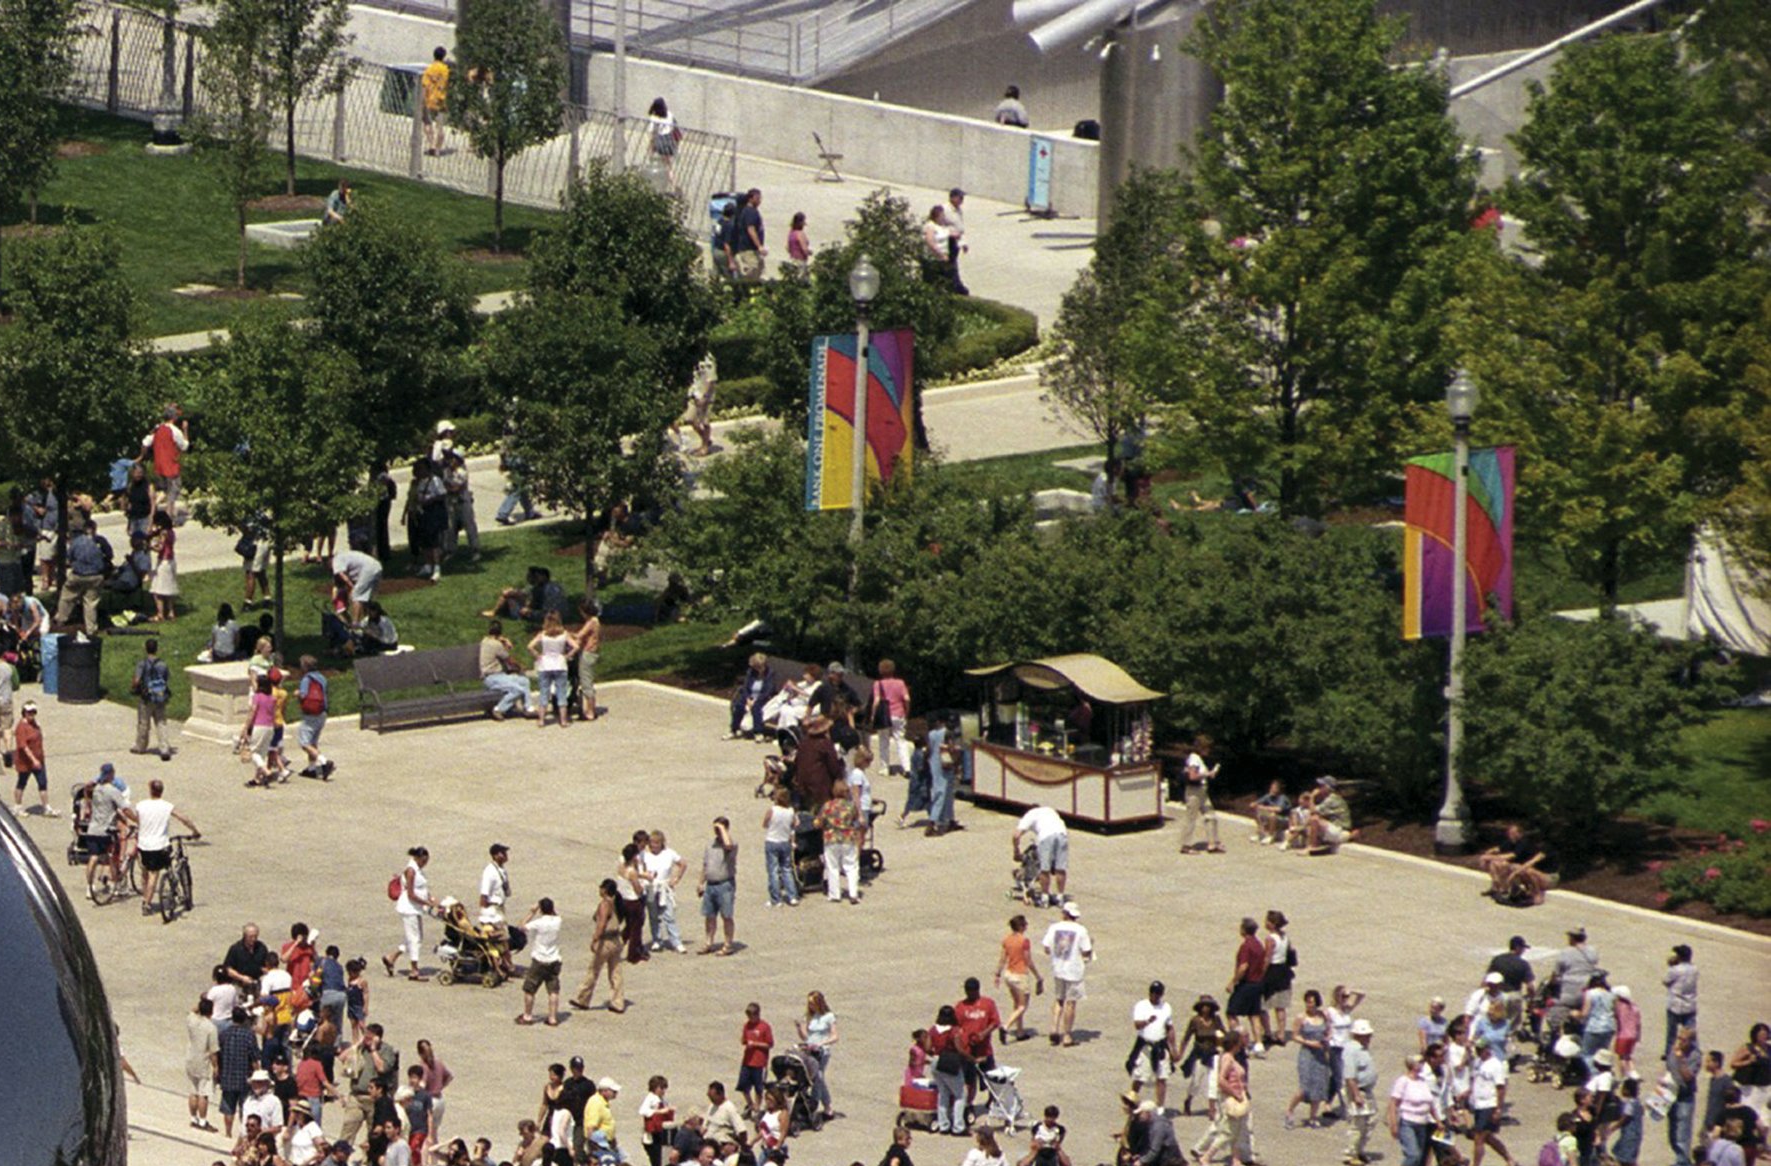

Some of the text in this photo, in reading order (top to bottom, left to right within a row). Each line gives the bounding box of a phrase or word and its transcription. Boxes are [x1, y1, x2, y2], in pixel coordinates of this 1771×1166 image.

[811, 345, 827, 506] BANK ONE PROMENADE
